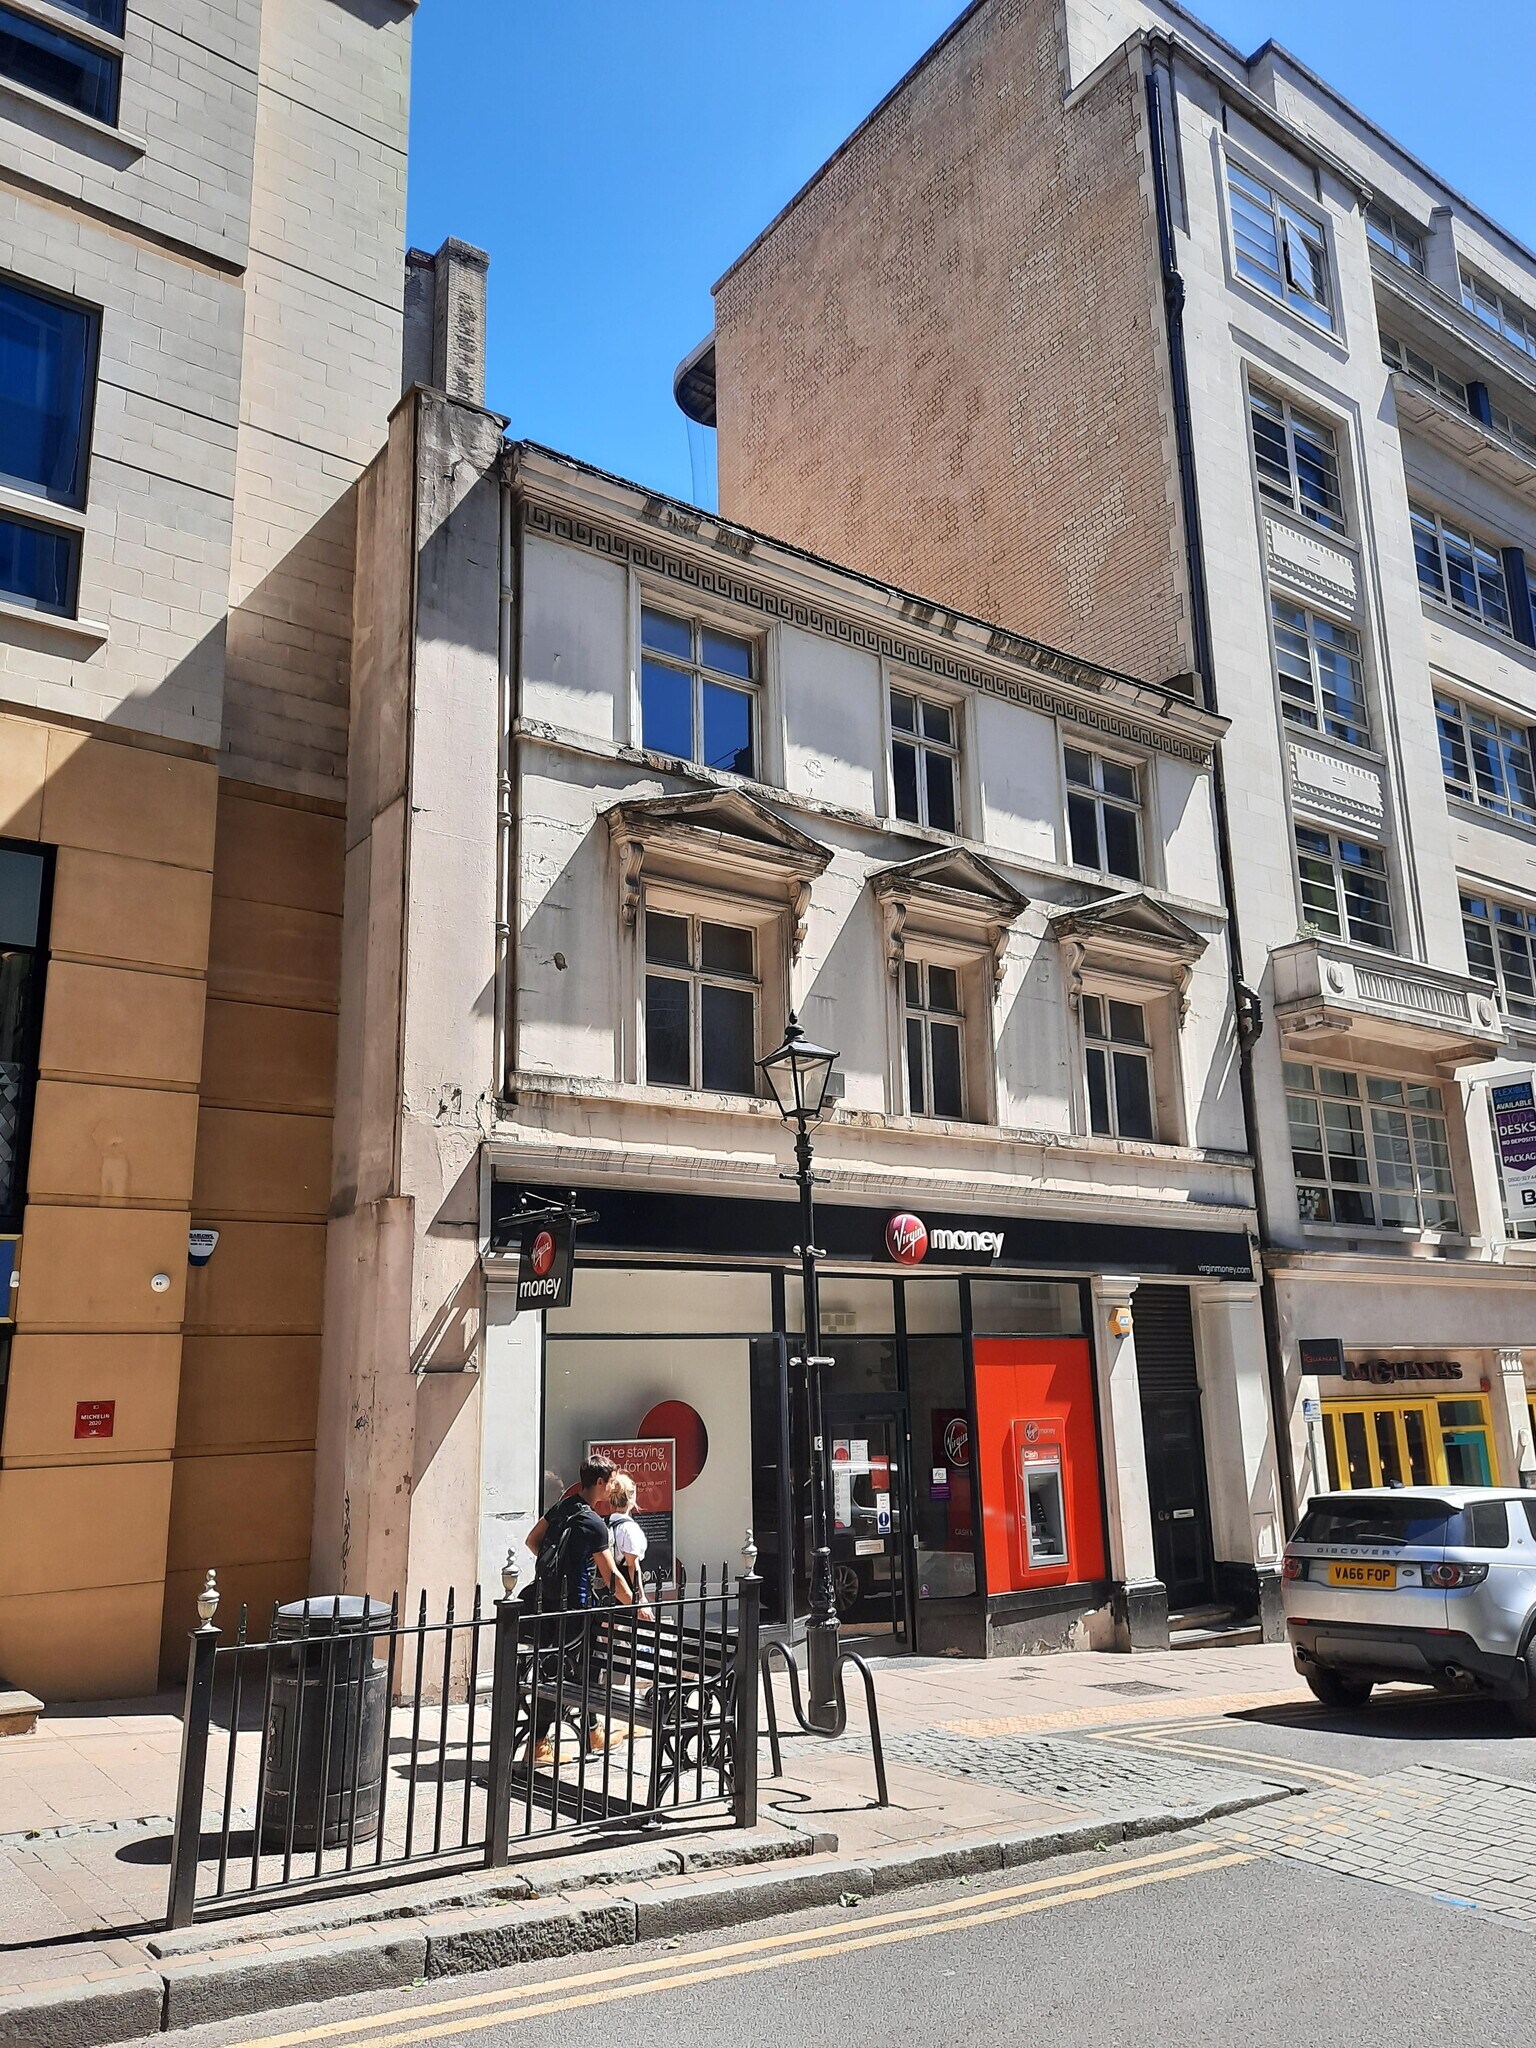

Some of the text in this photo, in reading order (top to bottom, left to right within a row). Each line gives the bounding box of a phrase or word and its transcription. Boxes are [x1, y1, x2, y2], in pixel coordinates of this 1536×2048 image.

[1493, 1084, 1530, 1097] FLEXIBLE
[1496, 1098, 1532, 1111] AVAILABLE
[1499, 1121, 1536, 1137] DESKS
[893, 1216, 1005, 1258] Virgin money
[1197, 1262, 1251, 1276] virginmoney.com
[519, 1277, 562, 1300] money
[1368, 1358, 1463, 1385] IGUANAS
[946, 1425, 969, 1458] Virgin
[591, 1445, 665, 1460] We're staying
[624, 1460, 642, 1473] for
[643, 1461, 668, 1473] now
[1316, 1546, 1402, 1557] DISCOVERY
[1334, 1566, 1391, 1582] VA66 FOP
